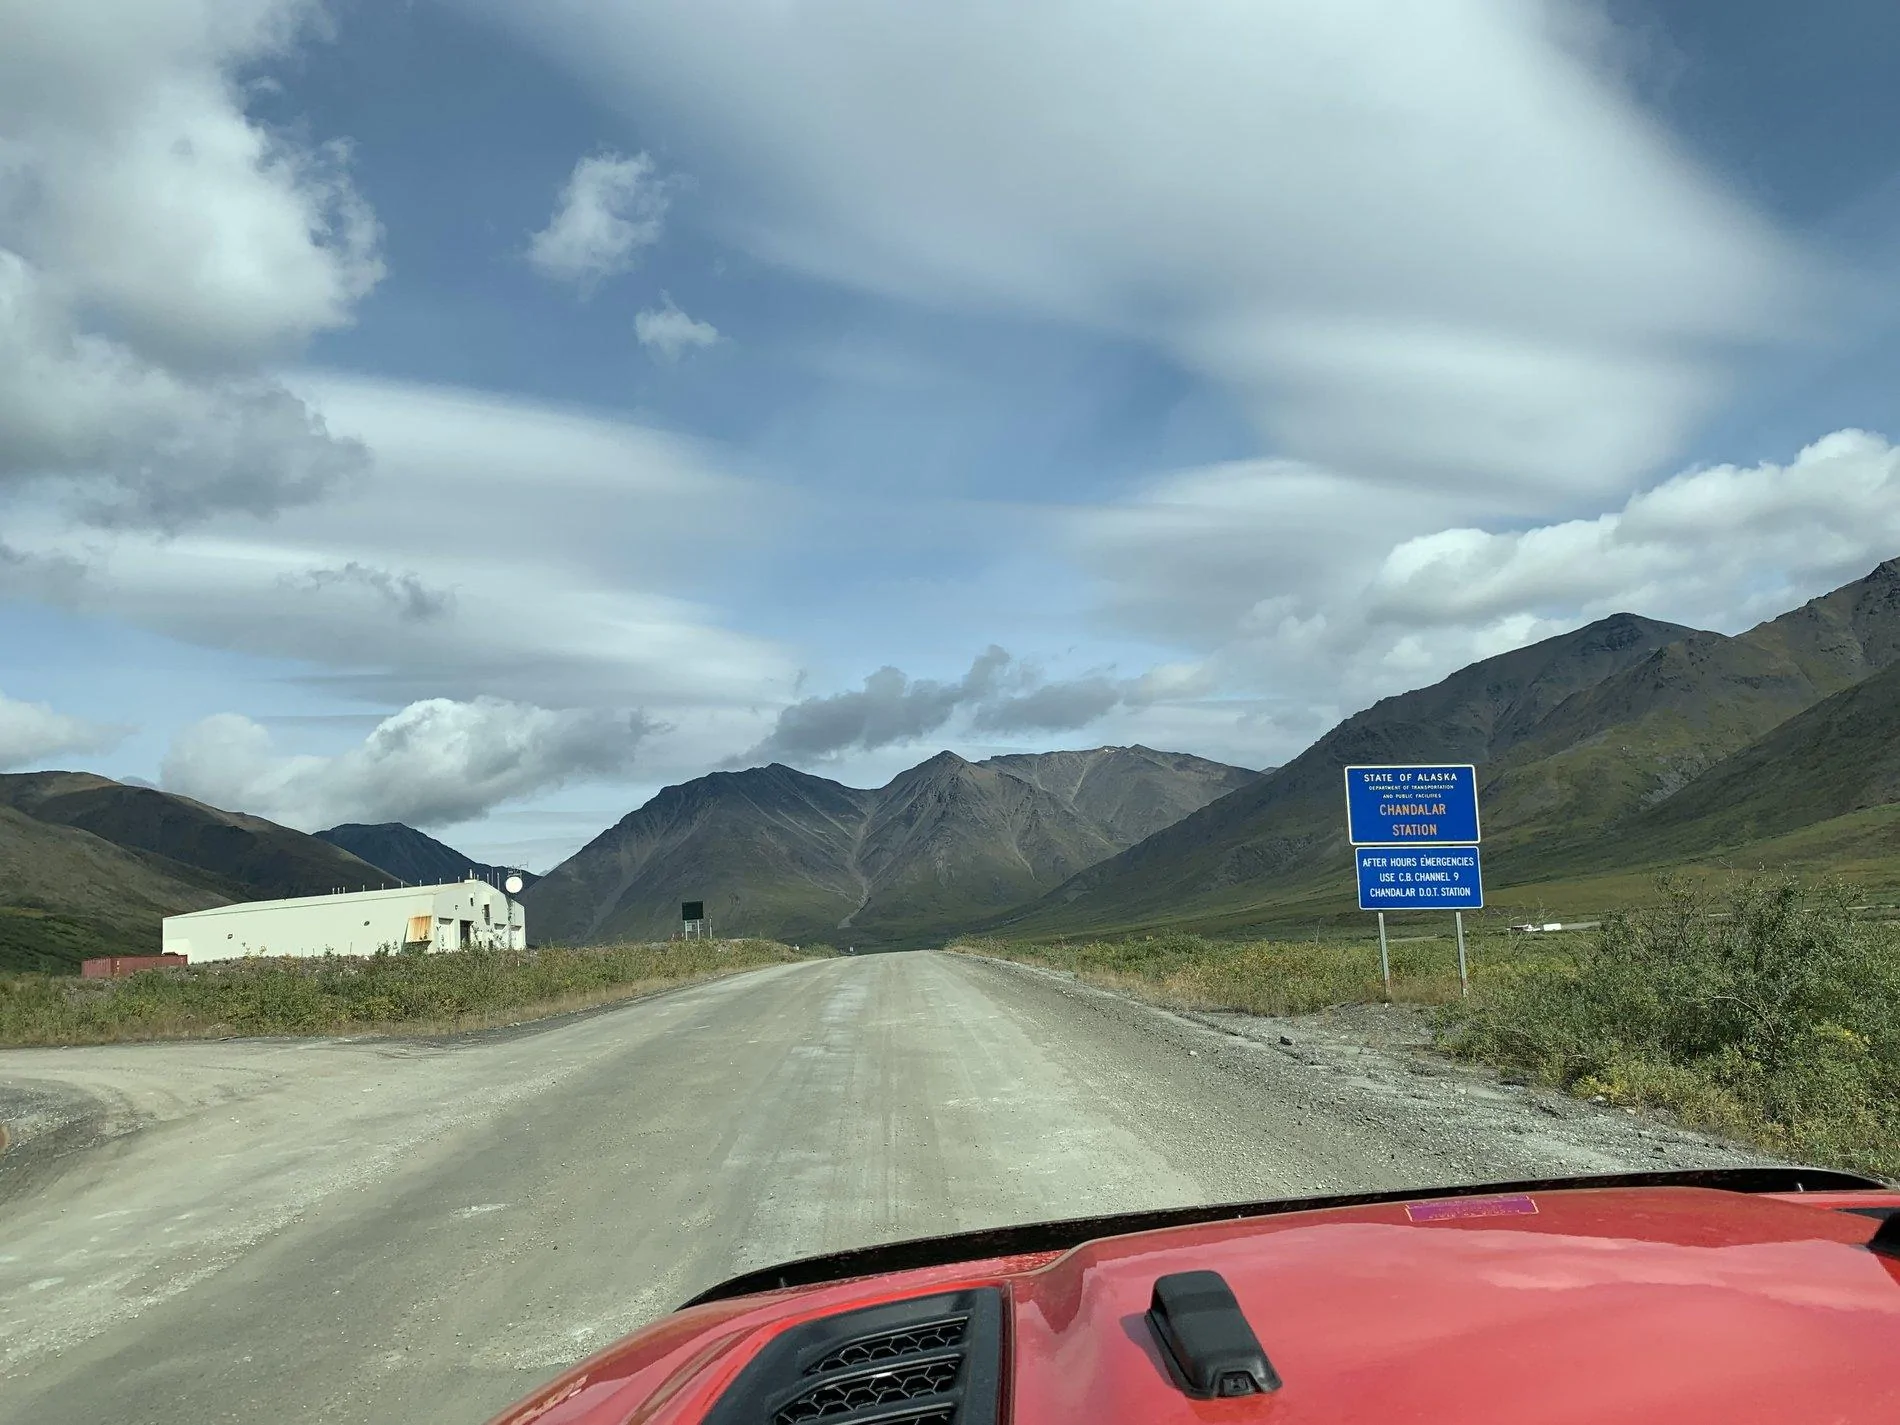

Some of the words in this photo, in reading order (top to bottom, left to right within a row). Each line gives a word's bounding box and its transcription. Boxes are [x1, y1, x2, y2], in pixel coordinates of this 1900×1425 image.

[1364, 774, 1392, 782] STATE
[1400, 774, 1411, 782] OF
[1418, 773, 1457, 781] ALASKA
[1380, 803, 1446, 816] CHANDALAR
[1392, 824, 1437, 836] STATION
[1363, 858, 1387, 867] AFTER
[1390, 857, 1416, 866] HOURS
[1420, 857, 1474, 866] EMERGENCIES
[1379, 873, 1395, 882] USE
[1399, 873, 1413, 882] C.B.
[1415, 872, 1450, 881] CHANNEL
[1453, 872, 1459, 881] 9
[1370, 888, 1415, 897] CHANDALAR
[1419, 888, 1439, 896] D.O.T.
[1441, 888, 1470, 896] STATION
